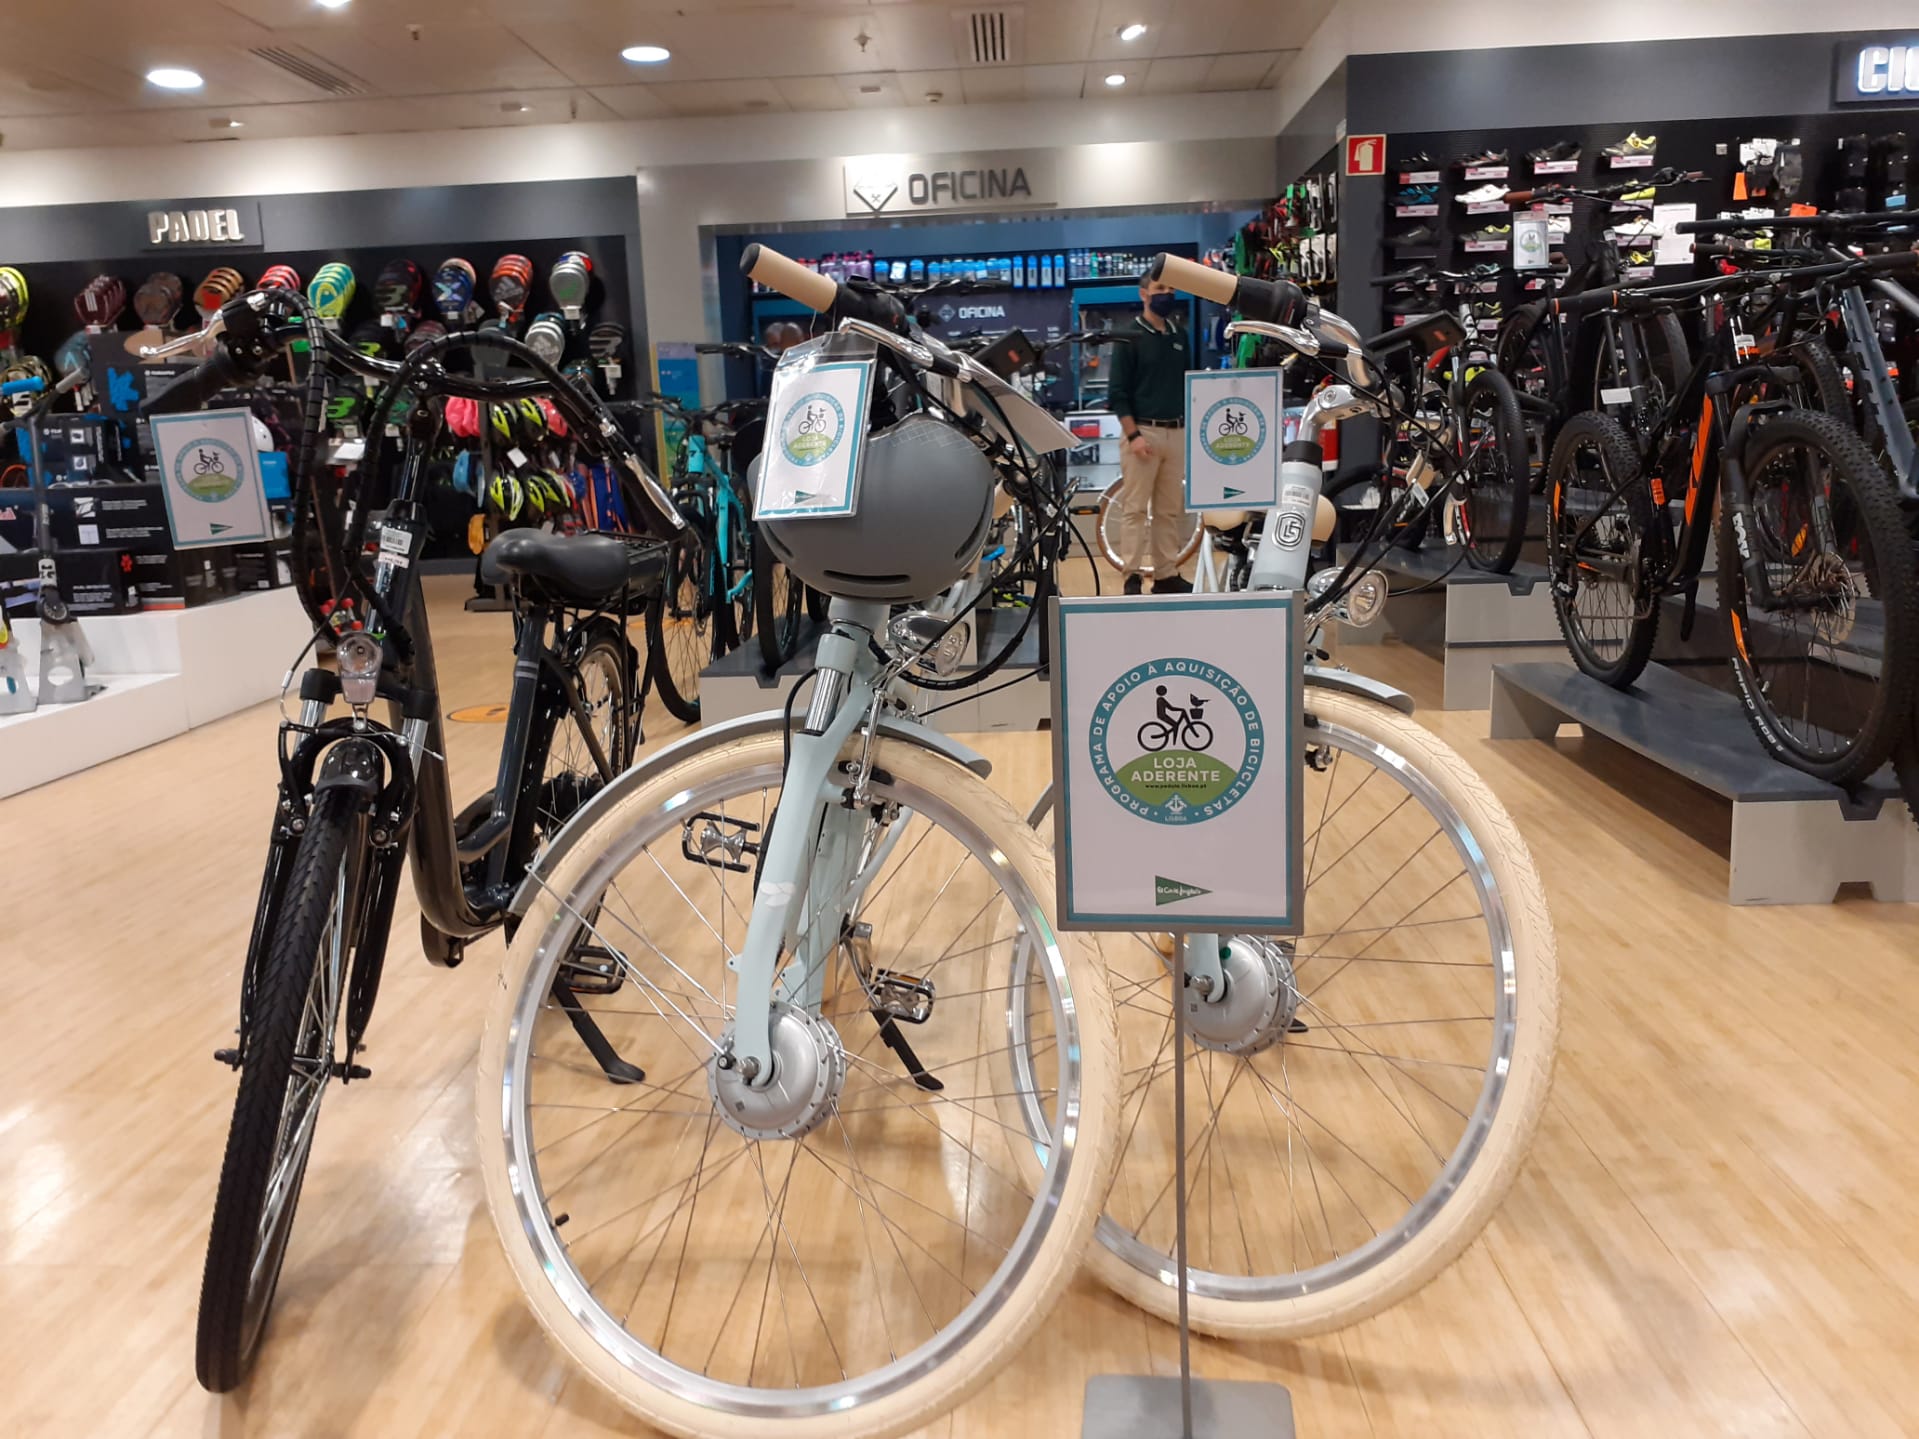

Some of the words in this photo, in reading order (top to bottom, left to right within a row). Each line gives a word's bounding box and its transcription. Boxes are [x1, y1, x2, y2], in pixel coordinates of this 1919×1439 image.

[908, 167, 1032, 206] OFICINA
[148, 209, 245, 244] PADEL
[958, 306, 1006, 319] OFICINA
[1147, 662, 1158, 675] À
[1102, 671, 1142, 711] APOIO
[1164, 661, 1248, 706] AQUISIÇÃO
[1093, 717, 1106, 736] DE
[1245, 711, 1259, 731] DE
[1131, 770, 1220, 782] ADERENTE
[1153, 757, 1197, 769] LOJA
[1093, 743, 1149, 816] PROGRAMA
[1203, 738, 1261, 816] BICICLETAS
